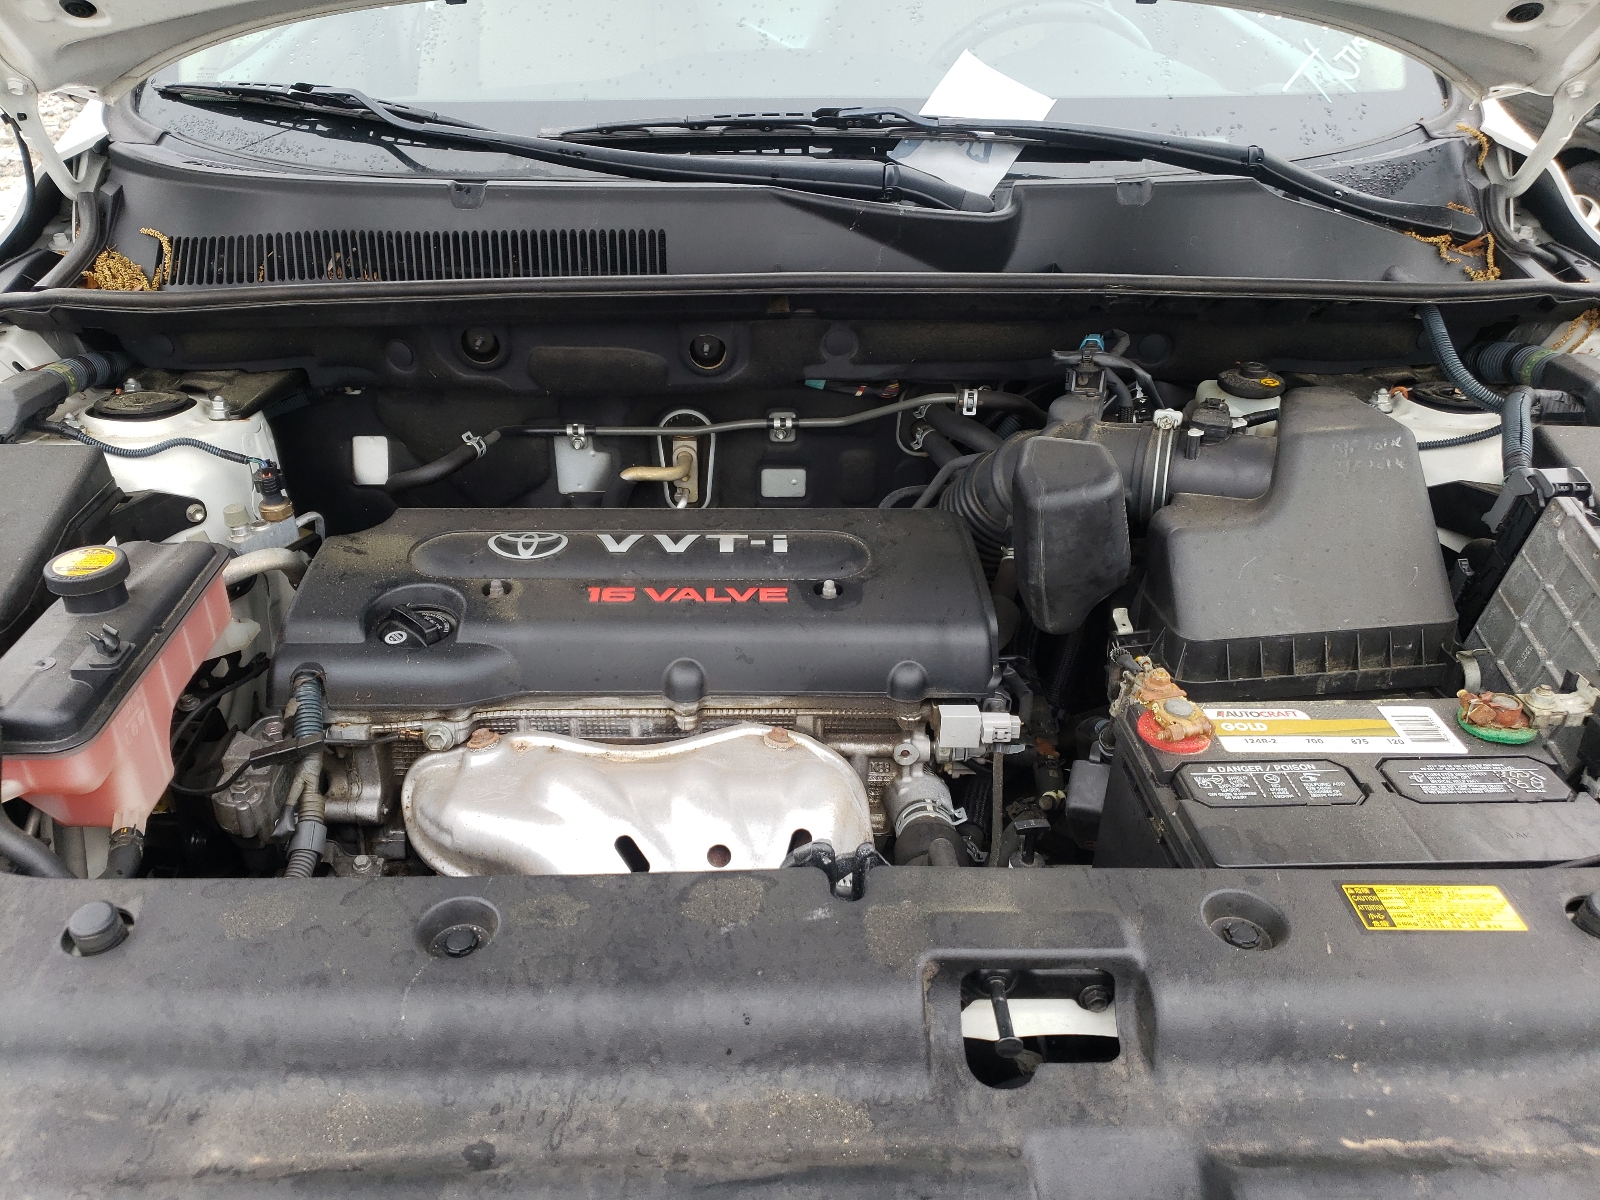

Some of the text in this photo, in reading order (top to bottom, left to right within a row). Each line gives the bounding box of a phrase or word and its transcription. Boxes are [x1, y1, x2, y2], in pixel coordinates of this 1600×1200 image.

[596, 534, 788, 553] VVT-i
[588, 586, 789, 603] 16 VALVE
[1225, 710, 1298, 719] AUTOCRAFT
[1220, 722, 1269, 732] GOLD
[1217, 765, 1263, 773] DANGER
[1273, 763, 1316, 772] POISON
